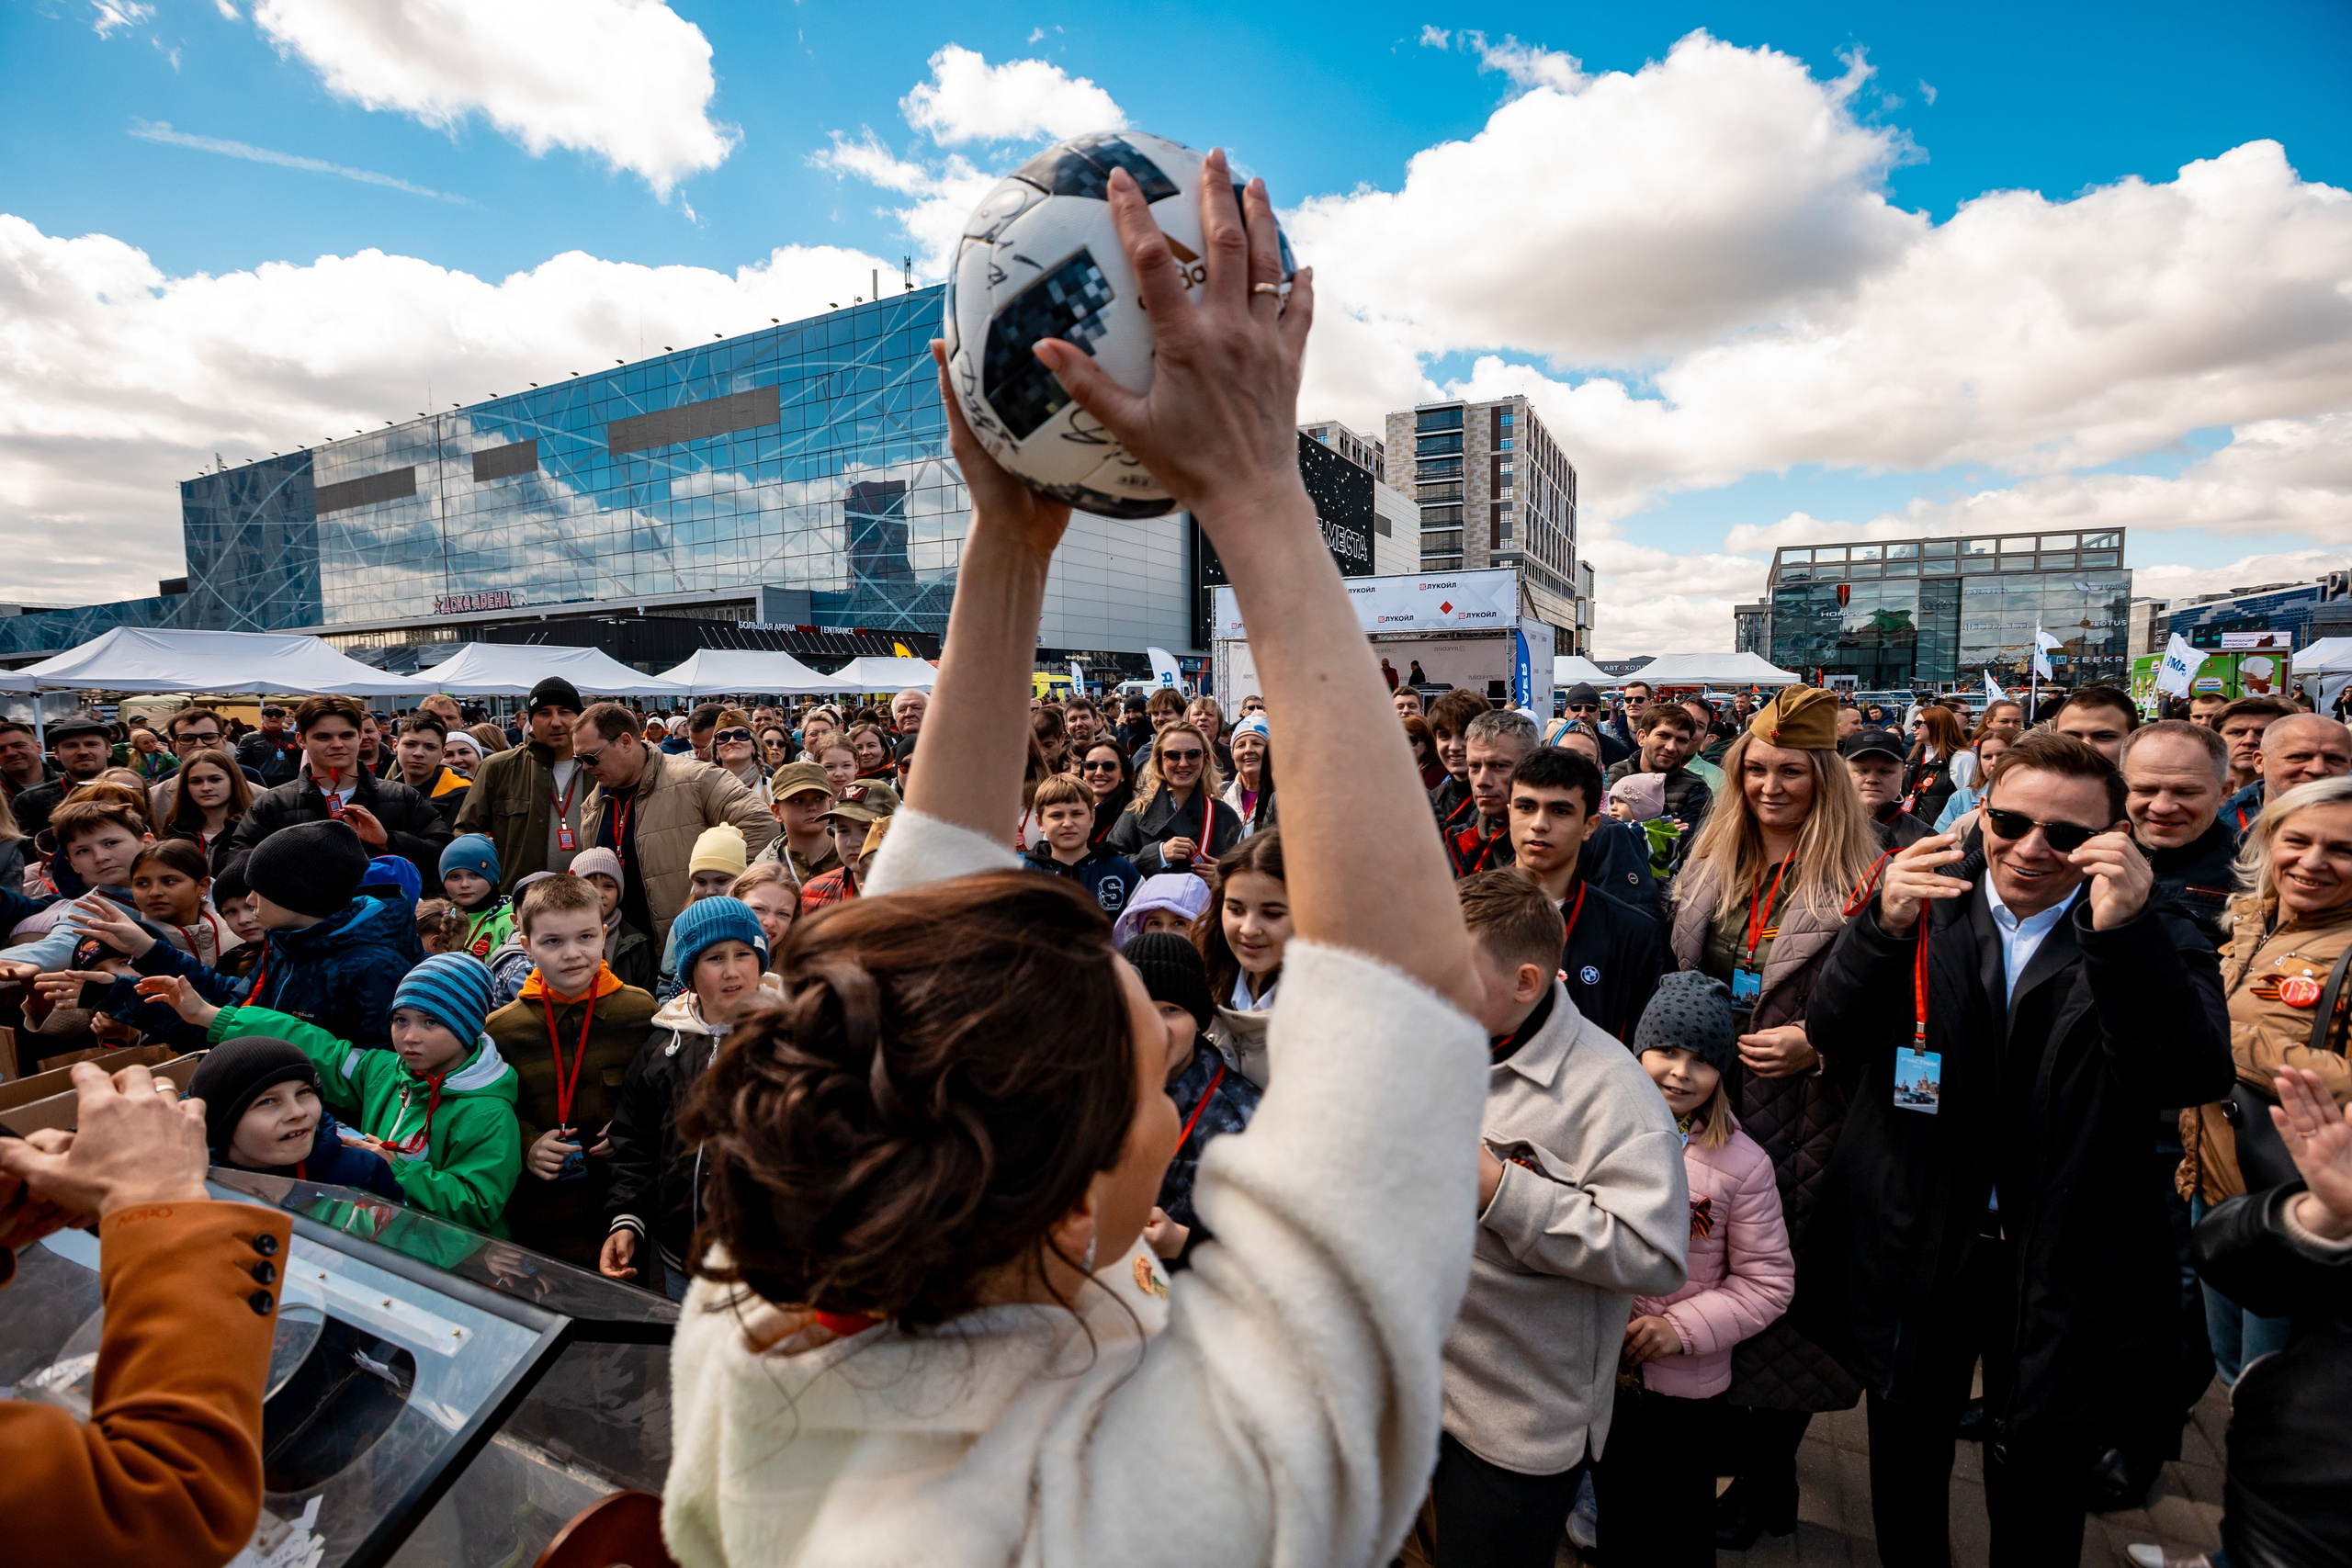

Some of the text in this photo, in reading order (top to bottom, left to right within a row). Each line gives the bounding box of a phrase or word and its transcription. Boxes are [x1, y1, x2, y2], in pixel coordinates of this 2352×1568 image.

[1325, 520, 1367, 561] МЕСТА
[1347, 586, 1376, 594] ЛУКОЙЛ
[1426, 581, 1457, 590] ЛУКОЙЛ
[443, 591, 510, 615] ЦСКА АРЕНА
[1465, 611, 1497, 619] ЛУКОЙЛ
[738, 620, 774, 631] БОЛЬШАЯ
[774, 623, 797, 632] АРЕНА
[823, 626, 854, 635] ENTRANCE
[1098, 875, 1124, 910] S
